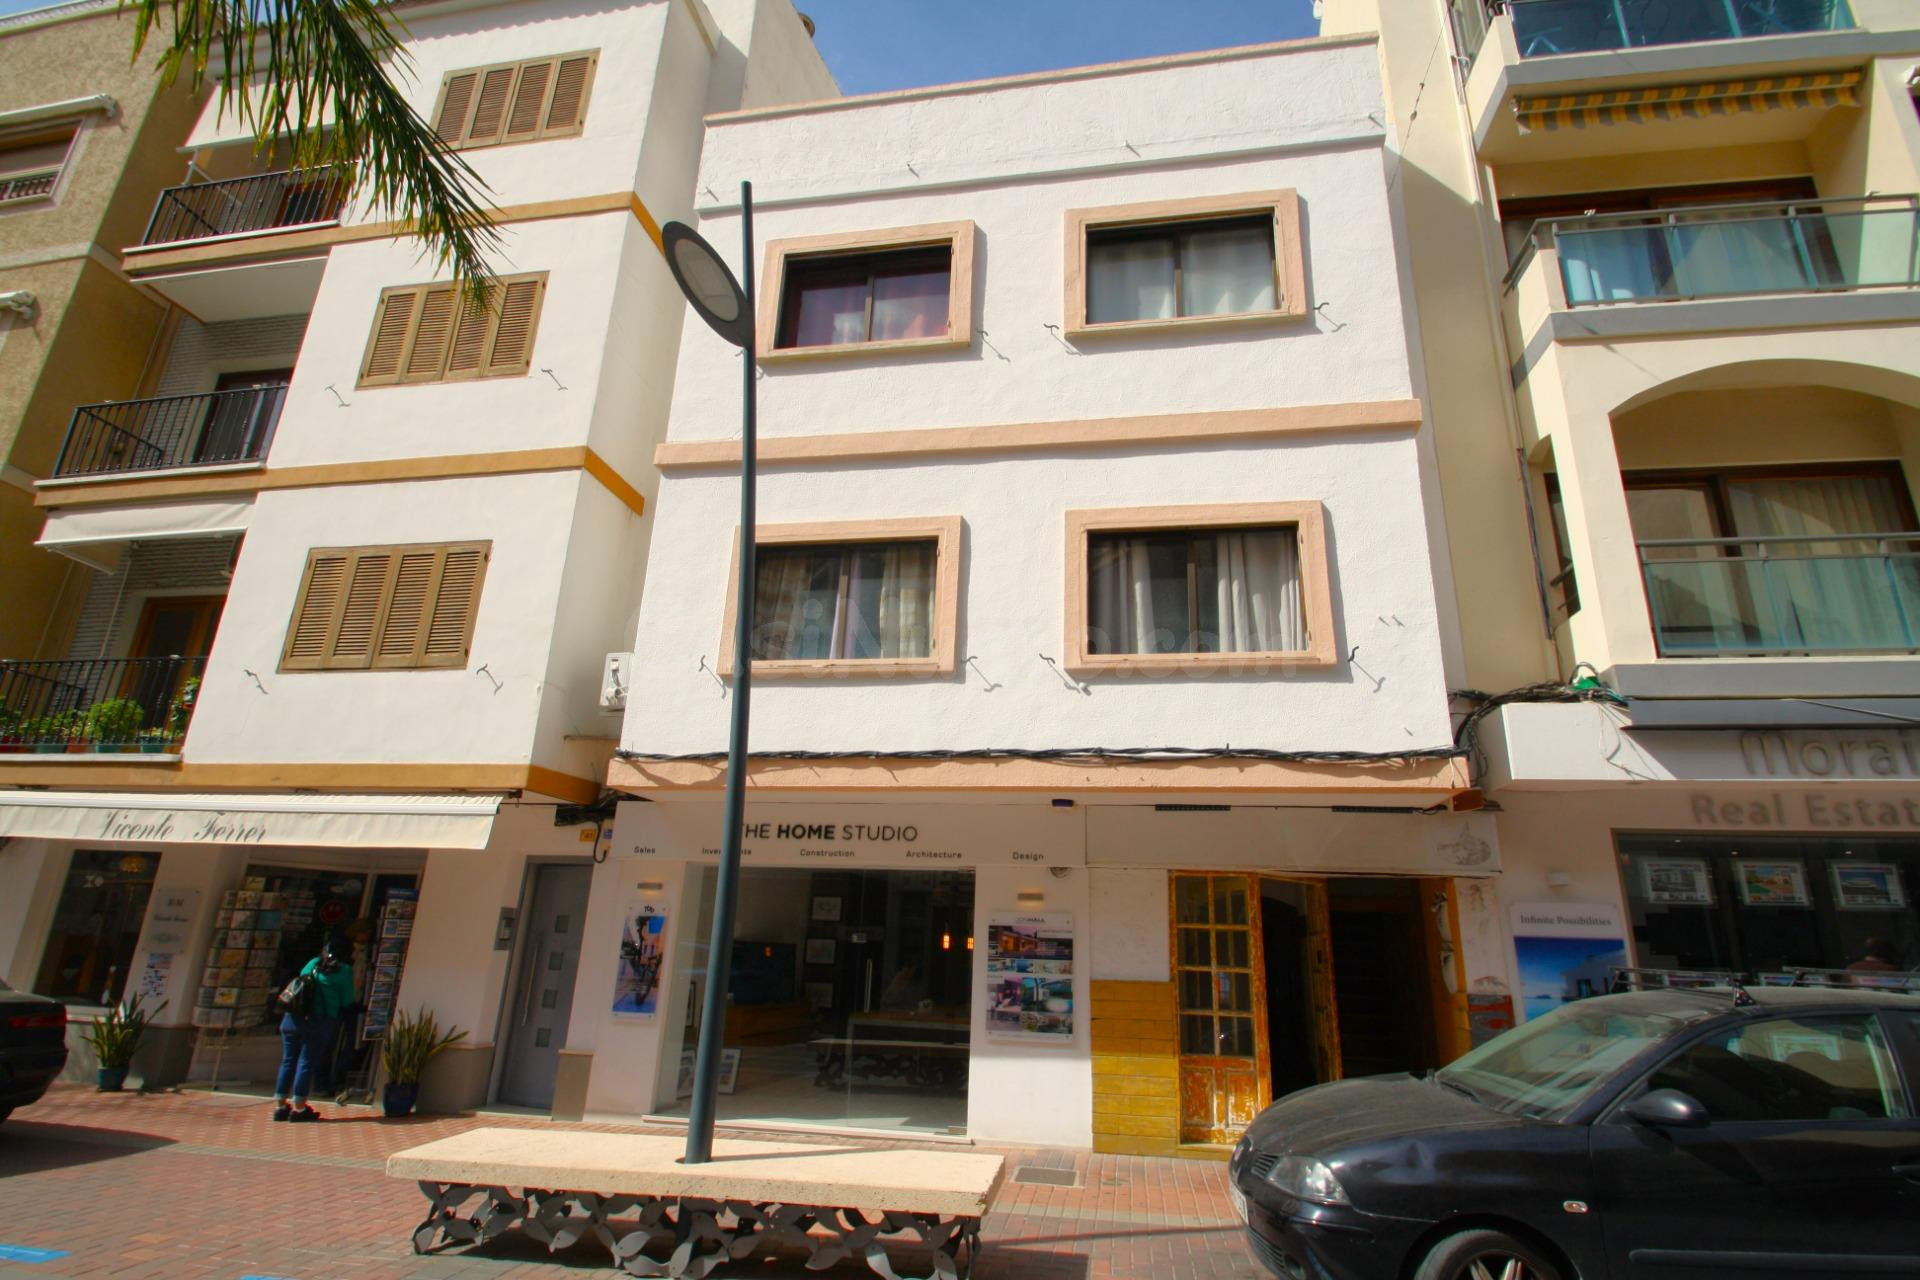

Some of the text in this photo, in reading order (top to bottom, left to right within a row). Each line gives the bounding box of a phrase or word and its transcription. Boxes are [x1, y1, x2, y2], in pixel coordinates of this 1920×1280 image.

[1690, 793, 1786, 826] Real
[100, 810, 267, 843] Vicente Ferrer
[743, 823, 919, 842] HE HOME STUDIO
[634, 846, 1045, 862] Sales Invets Construction Architecture Design
[1556, 915, 1613, 927] Possibilities
